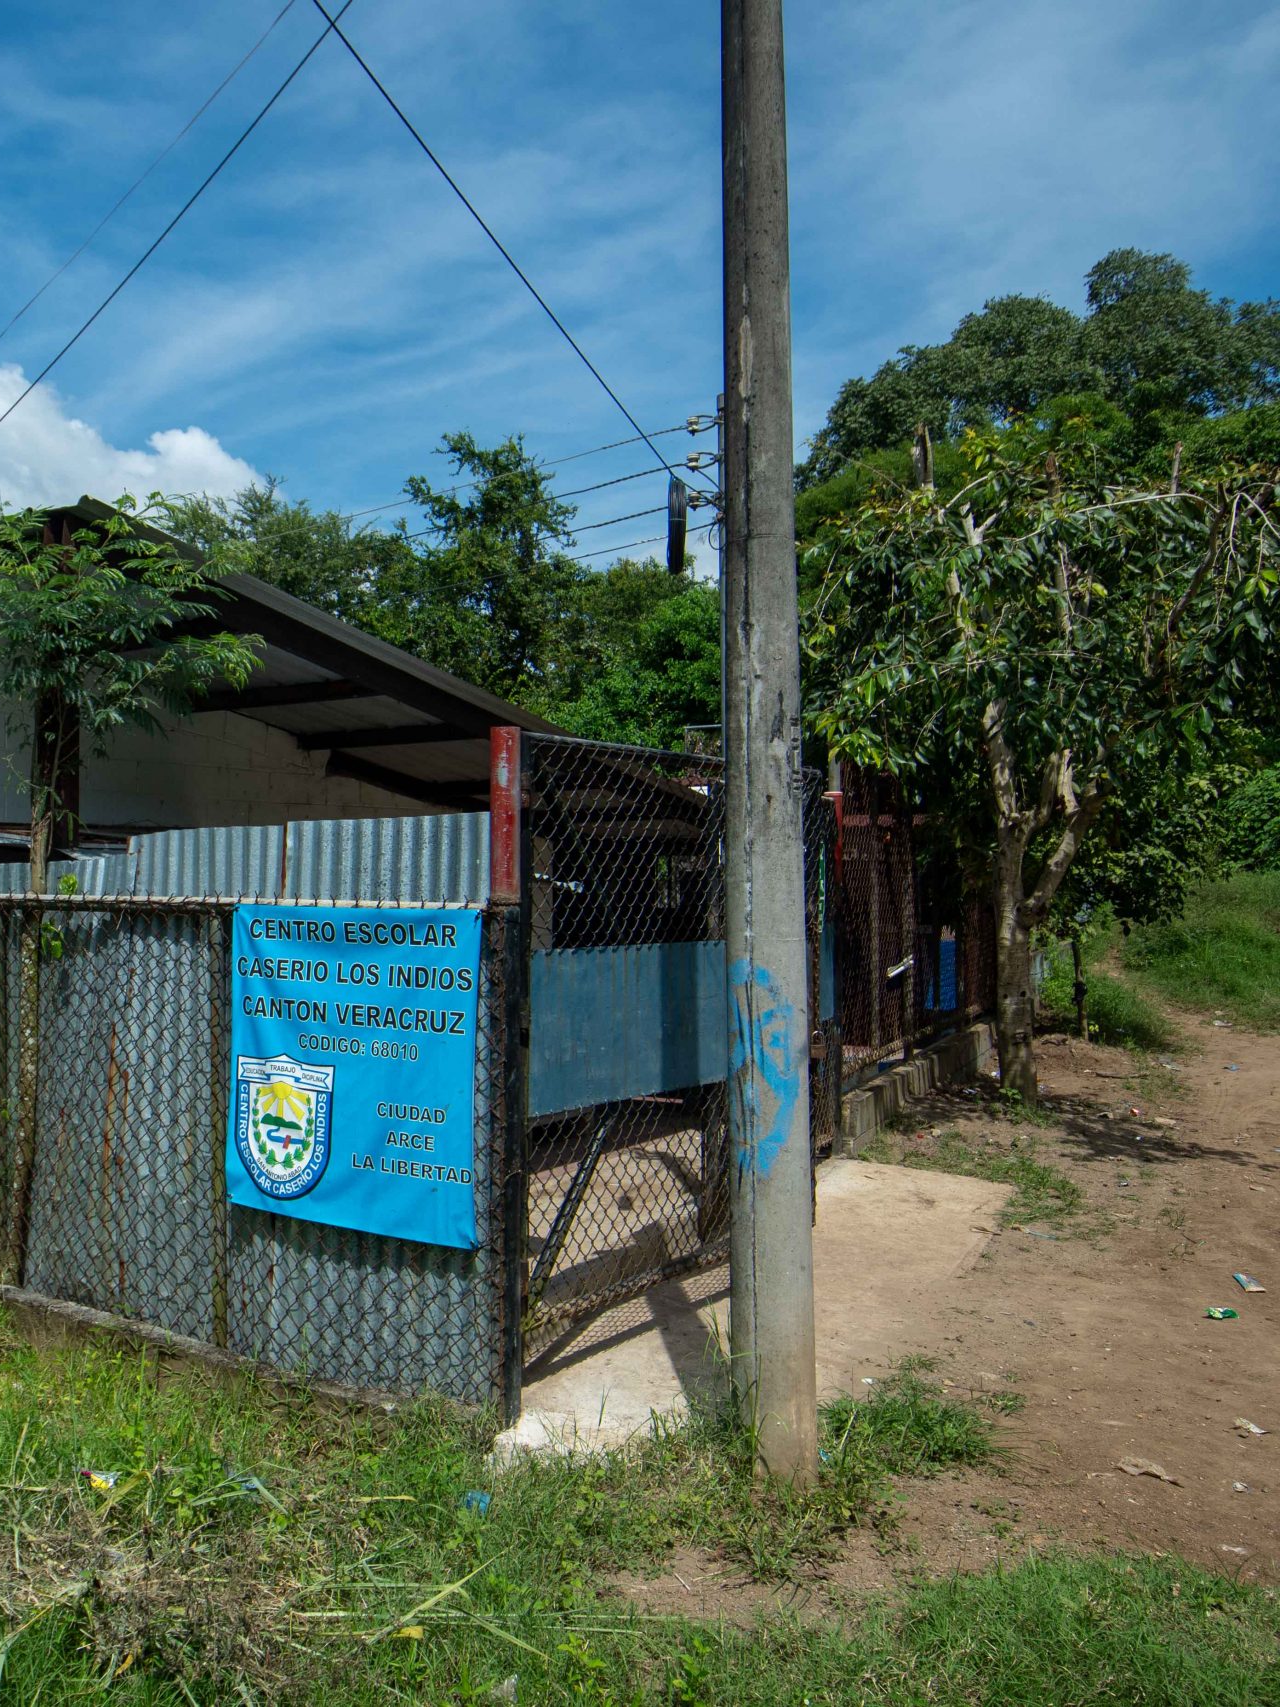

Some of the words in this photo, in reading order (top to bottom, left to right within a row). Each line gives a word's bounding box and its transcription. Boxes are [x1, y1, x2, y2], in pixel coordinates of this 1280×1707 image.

[249, 918, 336, 943] CENTRO
[343, 921, 457, 948] ESCOLAR
[236, 956, 328, 983] CASERIO
[336, 961, 380, 986] LOS
[388, 964, 473, 992] INDIOS
[242, 995, 327, 1024] CANTON
[335, 1002, 466, 1035] VERACRUZ
[298, 1033, 366, 1056] CODIGO:
[371, 1040, 419, 1062] 68010
[270, 1064, 296, 1073] TRABAJO
[239, 1084, 249, 1139] CENTRO
[316, 1093, 327, 1143] INDIOS
[377, 1101, 446, 1124] CIUDAD
[386, 1131, 435, 1152] ARCE
[240, 1141, 272, 1192] ESCOLAR
[256, 1157, 266, 1170] SAN
[265, 1169, 287, 1180] ANTONIO
[311, 1146, 324, 1170] LOS
[351, 1153, 374, 1170] LA
[380, 1157, 472, 1185] LIBERTAD
[272, 1169, 313, 1195] CASERIO
